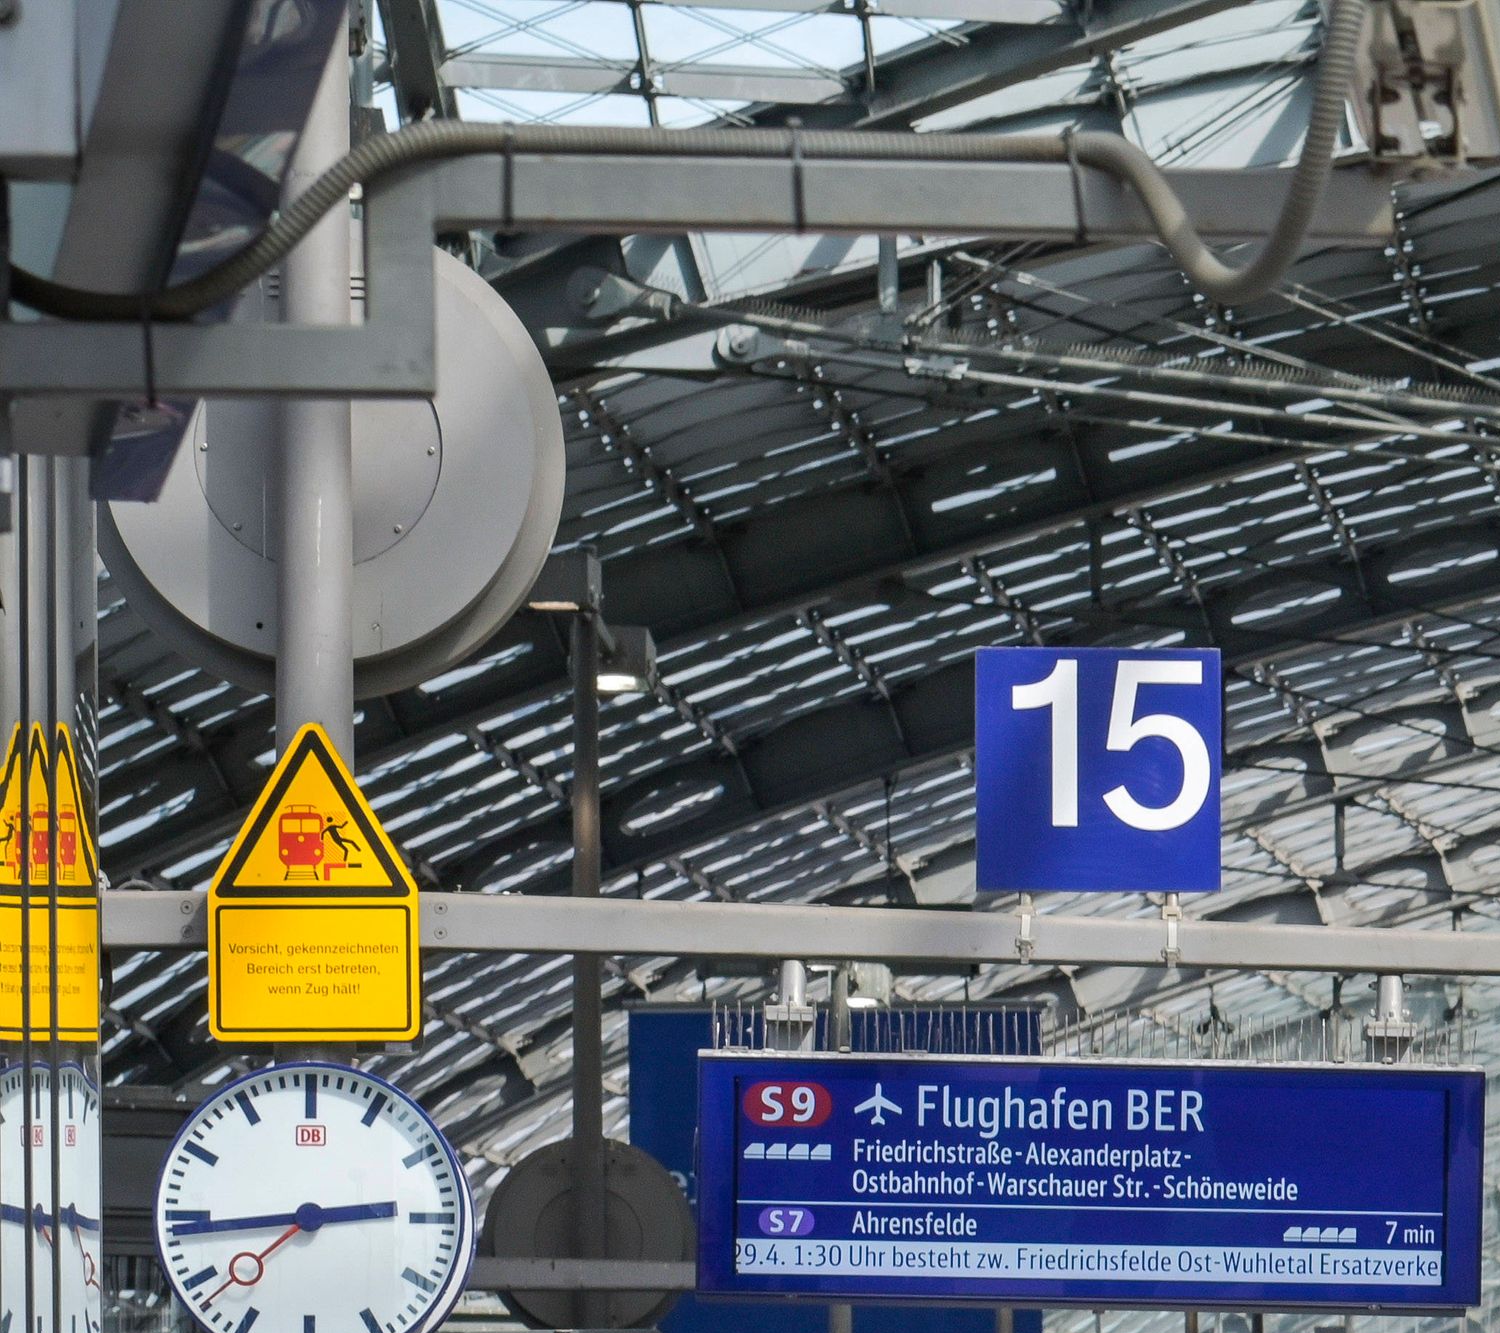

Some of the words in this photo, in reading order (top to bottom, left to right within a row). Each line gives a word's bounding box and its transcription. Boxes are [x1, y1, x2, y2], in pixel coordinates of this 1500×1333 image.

[1011, 658, 1212, 832] 15
[228, 943, 282, 955] Vorsicht,
[286, 942, 399, 956] gekennzeichneten
[246, 963, 293, 974] Bereich
[297, 964, 321, 974] erst
[325, 963, 381, 976] betreten,
[268, 984, 301, 994] wenn
[305, 982, 329, 996] Zug
[333, 982, 360, 995] hält!
[917, 1084, 1113, 1139] Flughafen
[1127, 1088, 1205, 1133] BER
[300, 1128, 322, 1145] DB
[851, 1210, 978, 1236] Ahrensfelde
[1385, 1220, 1399, 1245] 7
[1403, 1225, 1436, 1244] min
[794, 1243, 843, 1267] 1:30
[849, 1245, 886, 1268] Uhr
[891, 1247, 971, 1270] besteht
[976, 1252, 1010, 1269] zw.
[1016, 1248, 1172, 1273] Friedrichsfelde
[1177, 1250, 1314, 1275] Ost-Wuhletal
[1320, 1252, 1443, 1278] Ersatzverke
